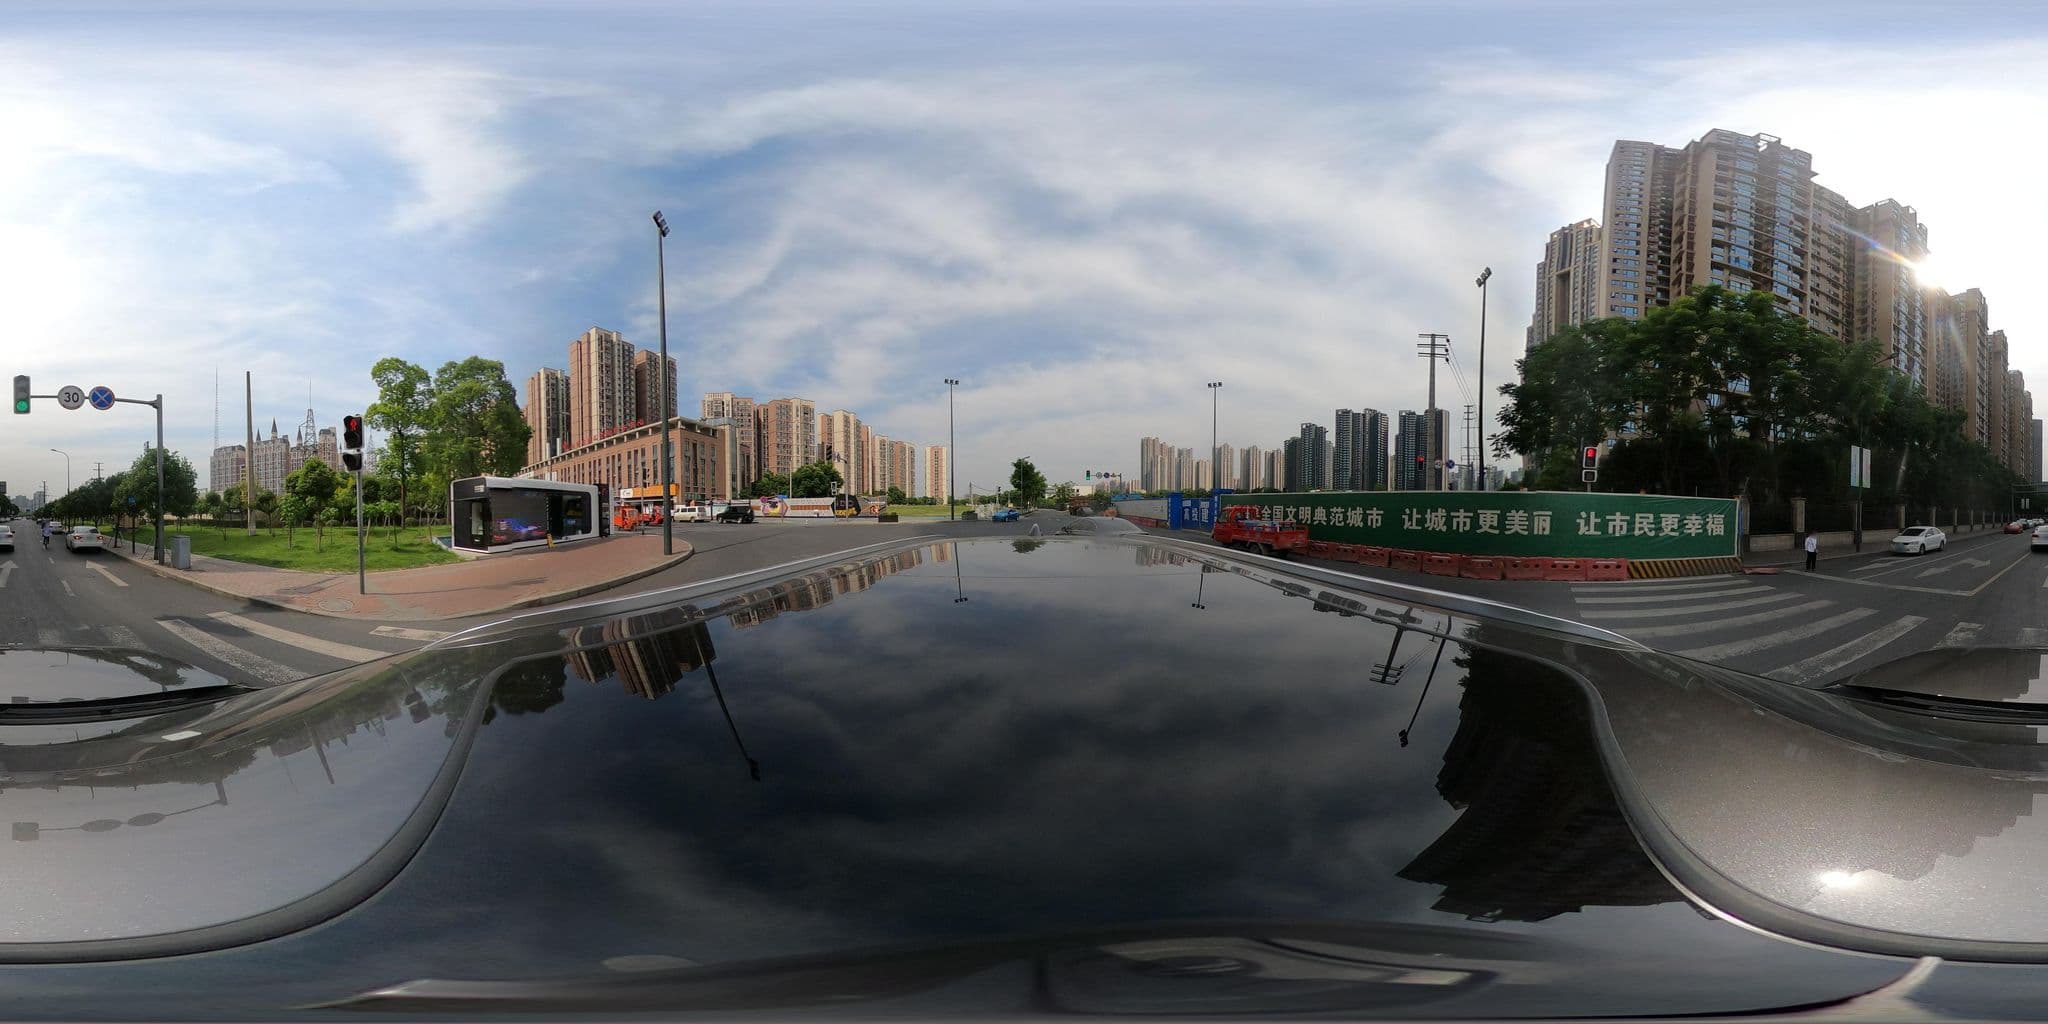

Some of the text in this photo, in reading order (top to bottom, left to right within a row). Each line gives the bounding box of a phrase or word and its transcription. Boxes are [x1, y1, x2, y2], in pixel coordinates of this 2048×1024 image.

[63, 392, 80, 403] 30
[1401, 507, 1553, 536] 让城市更美丽
[1576, 511, 1726, 537] 让市民更幸福
